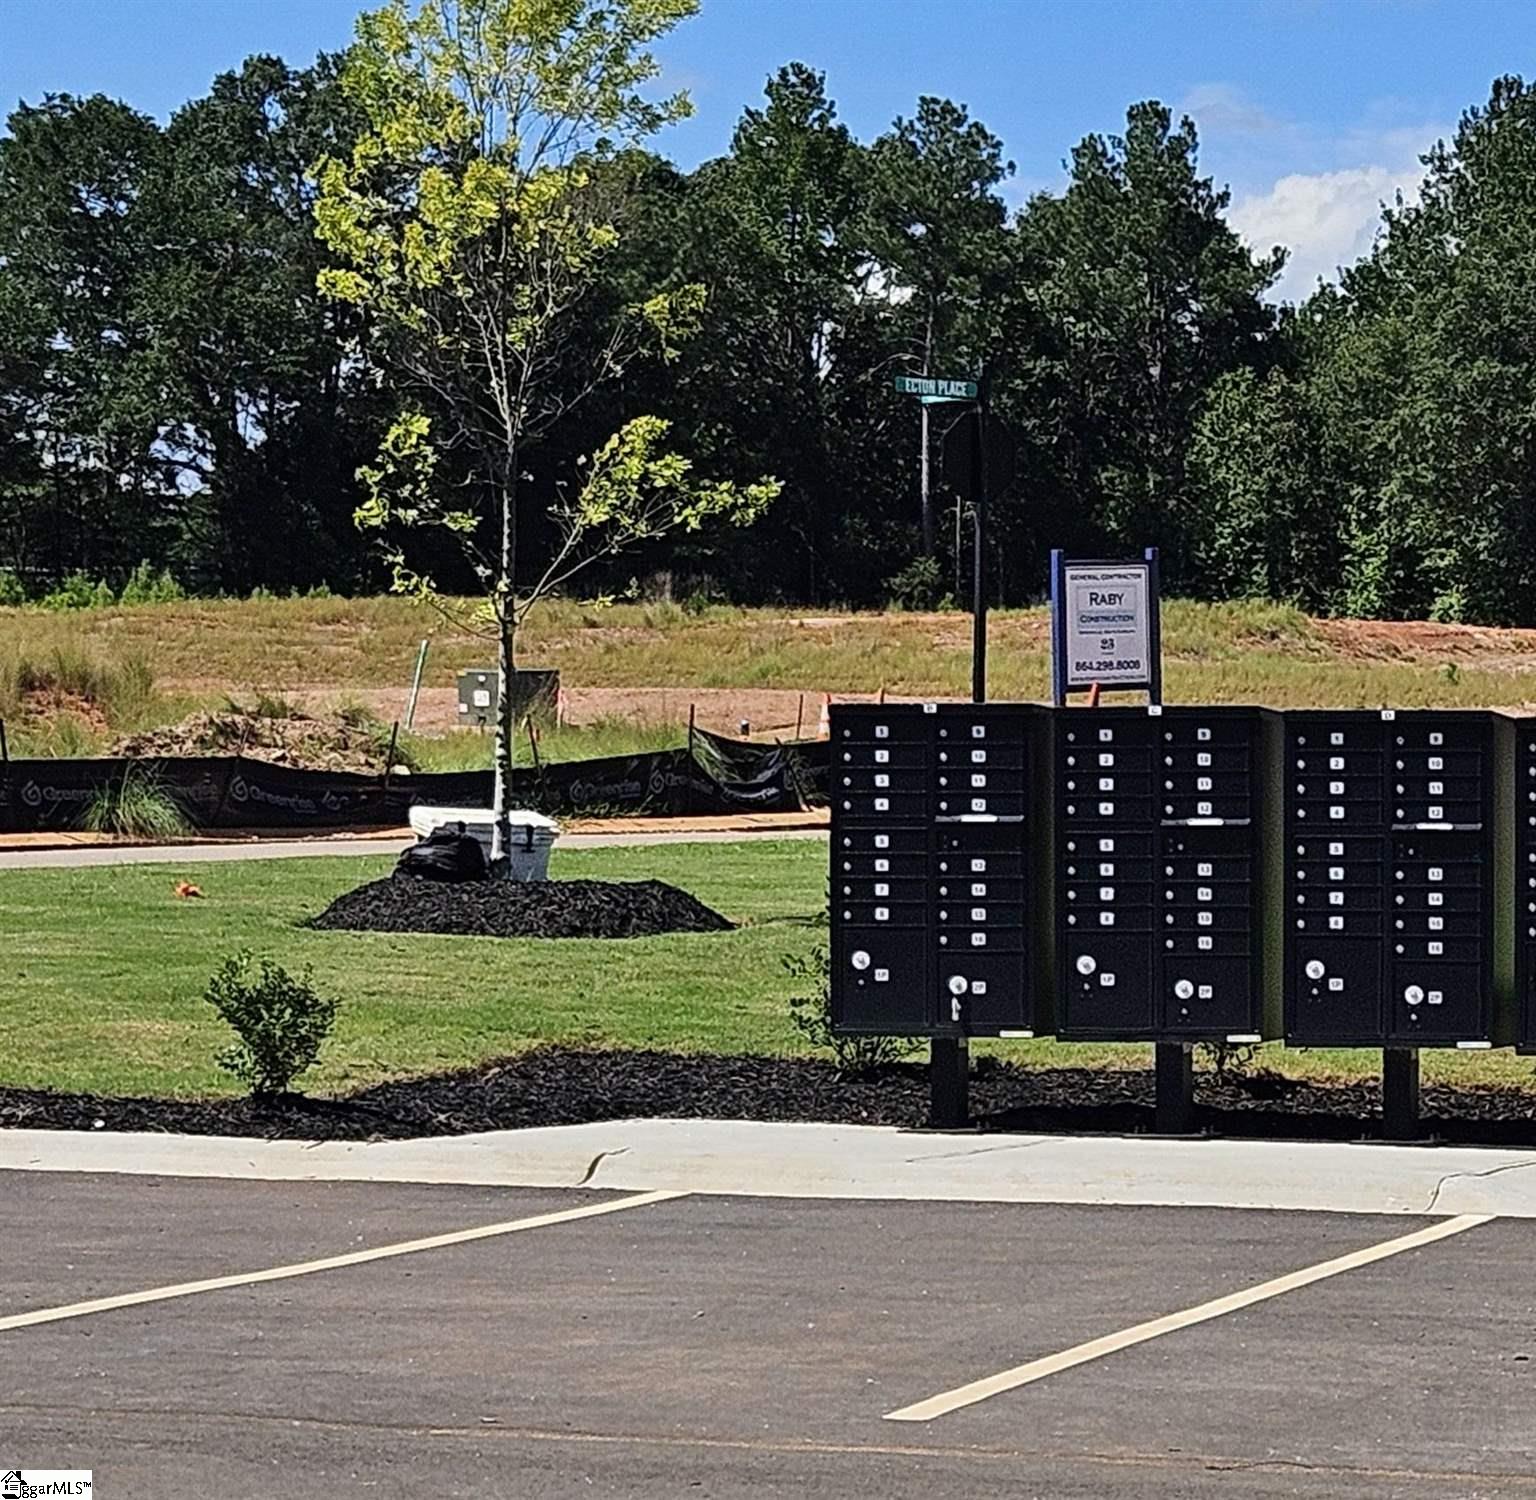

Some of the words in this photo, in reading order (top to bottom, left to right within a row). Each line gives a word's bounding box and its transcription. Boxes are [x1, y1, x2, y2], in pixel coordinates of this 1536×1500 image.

[905, 377, 936, 394] ECTON
[937, 379, 968, 397] PLACE
[1089, 592, 1124, 606] RABY
